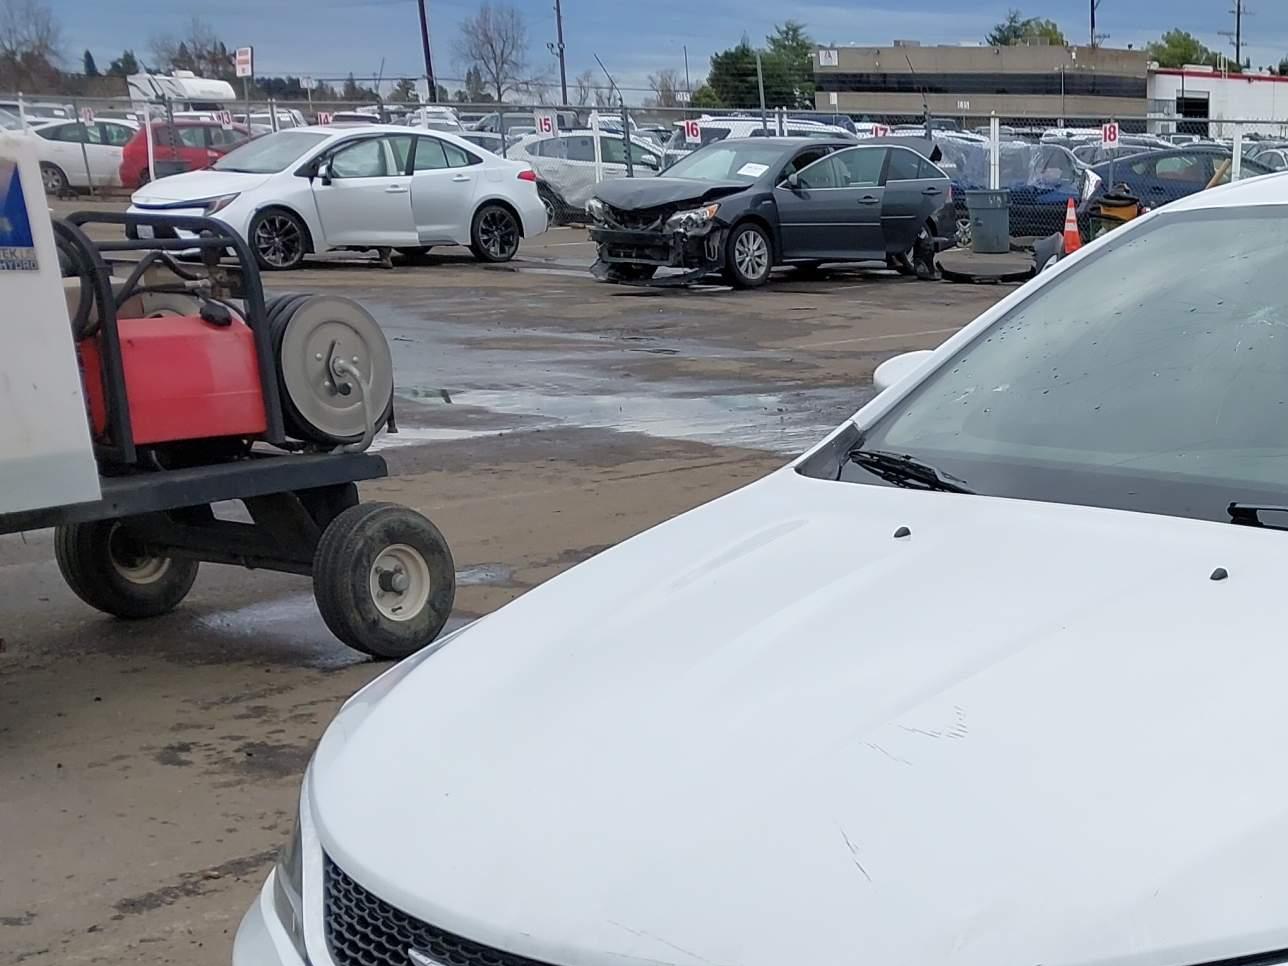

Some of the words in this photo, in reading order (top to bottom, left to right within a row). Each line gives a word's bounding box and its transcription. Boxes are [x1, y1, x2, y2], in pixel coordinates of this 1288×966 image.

[539, 117, 552, 133] 15
[686, 121, 699, 138] 16
[874, 126, 889, 137] 17
[1103, 124, 1117, 143] 18
